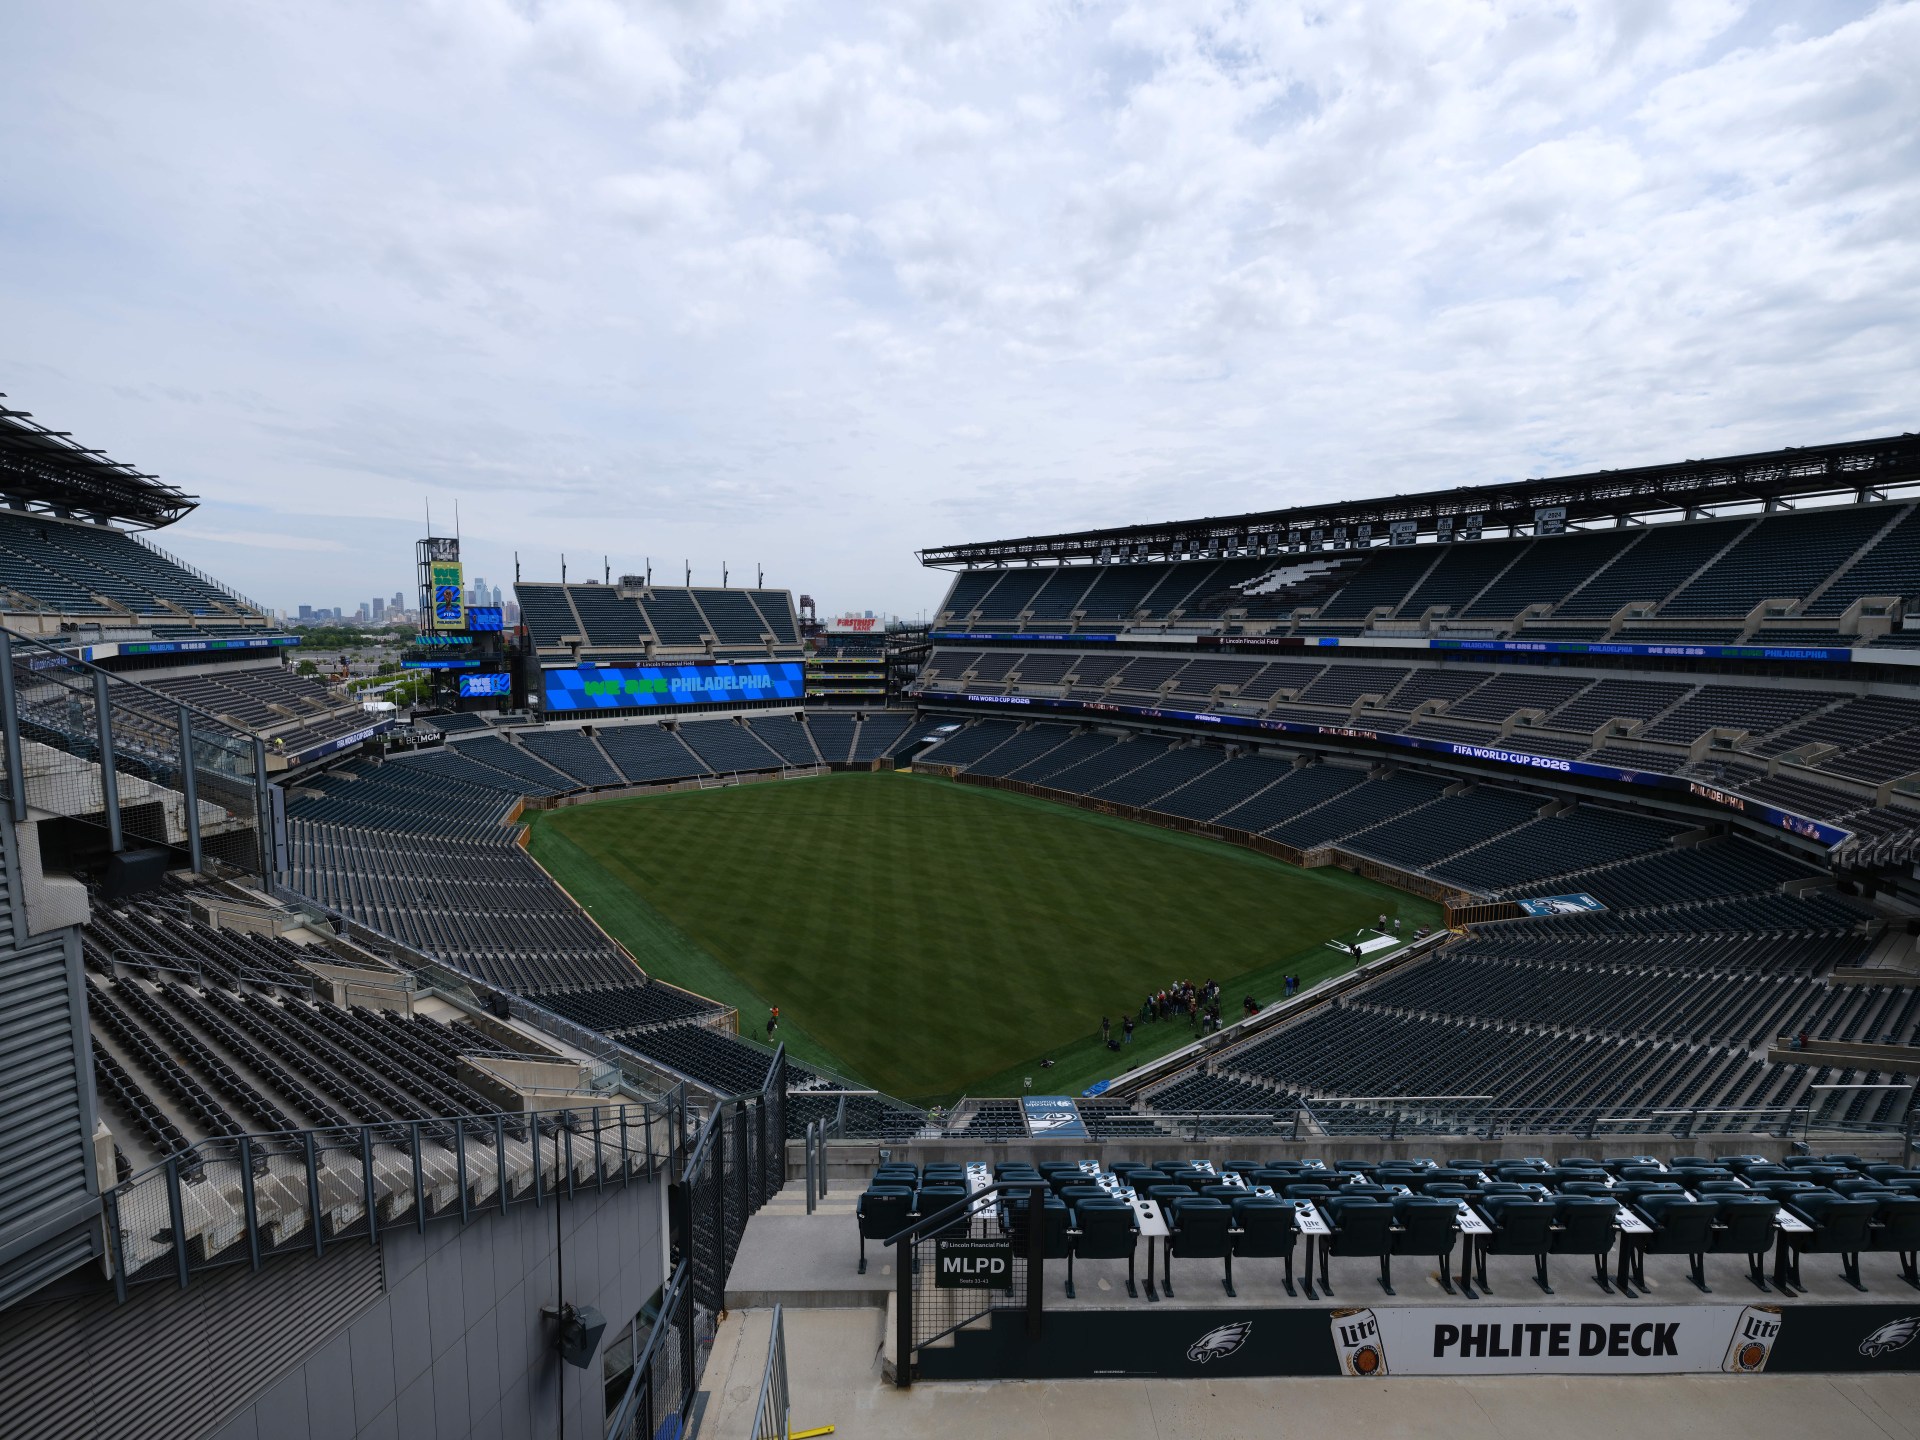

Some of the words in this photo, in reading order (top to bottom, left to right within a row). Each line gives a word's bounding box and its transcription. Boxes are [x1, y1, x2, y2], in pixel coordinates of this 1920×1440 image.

[1764, 650, 1828, 659] PHILADELPHIA
[584, 680, 620, 696] WE
[624, 678, 668, 694] ARE
[672, 674, 771, 692] PHILADELPHIA
[1083, 703, 1119, 711] PHILADELPHIA
[406, 733, 440, 745] BETMGM
[1318, 726, 1377, 740] PHILADELPHIA
[1453, 745, 1473, 756] FIFA
[1473, 748, 1508, 761] WORLD
[1509, 754, 1531, 764] CUP
[1531, 757, 1570, 771] 2026
[1690, 782, 1745, 811] PHILADELPHIA
[943, 1257, 1005, 1273] MLPD
[1338, 1320, 1376, 1347] Lite
[1742, 1316, 1779, 1340] Lite
[1433, 1323, 1571, 1357] PHLITE
[1579, 1322, 1680, 1357] DECK
